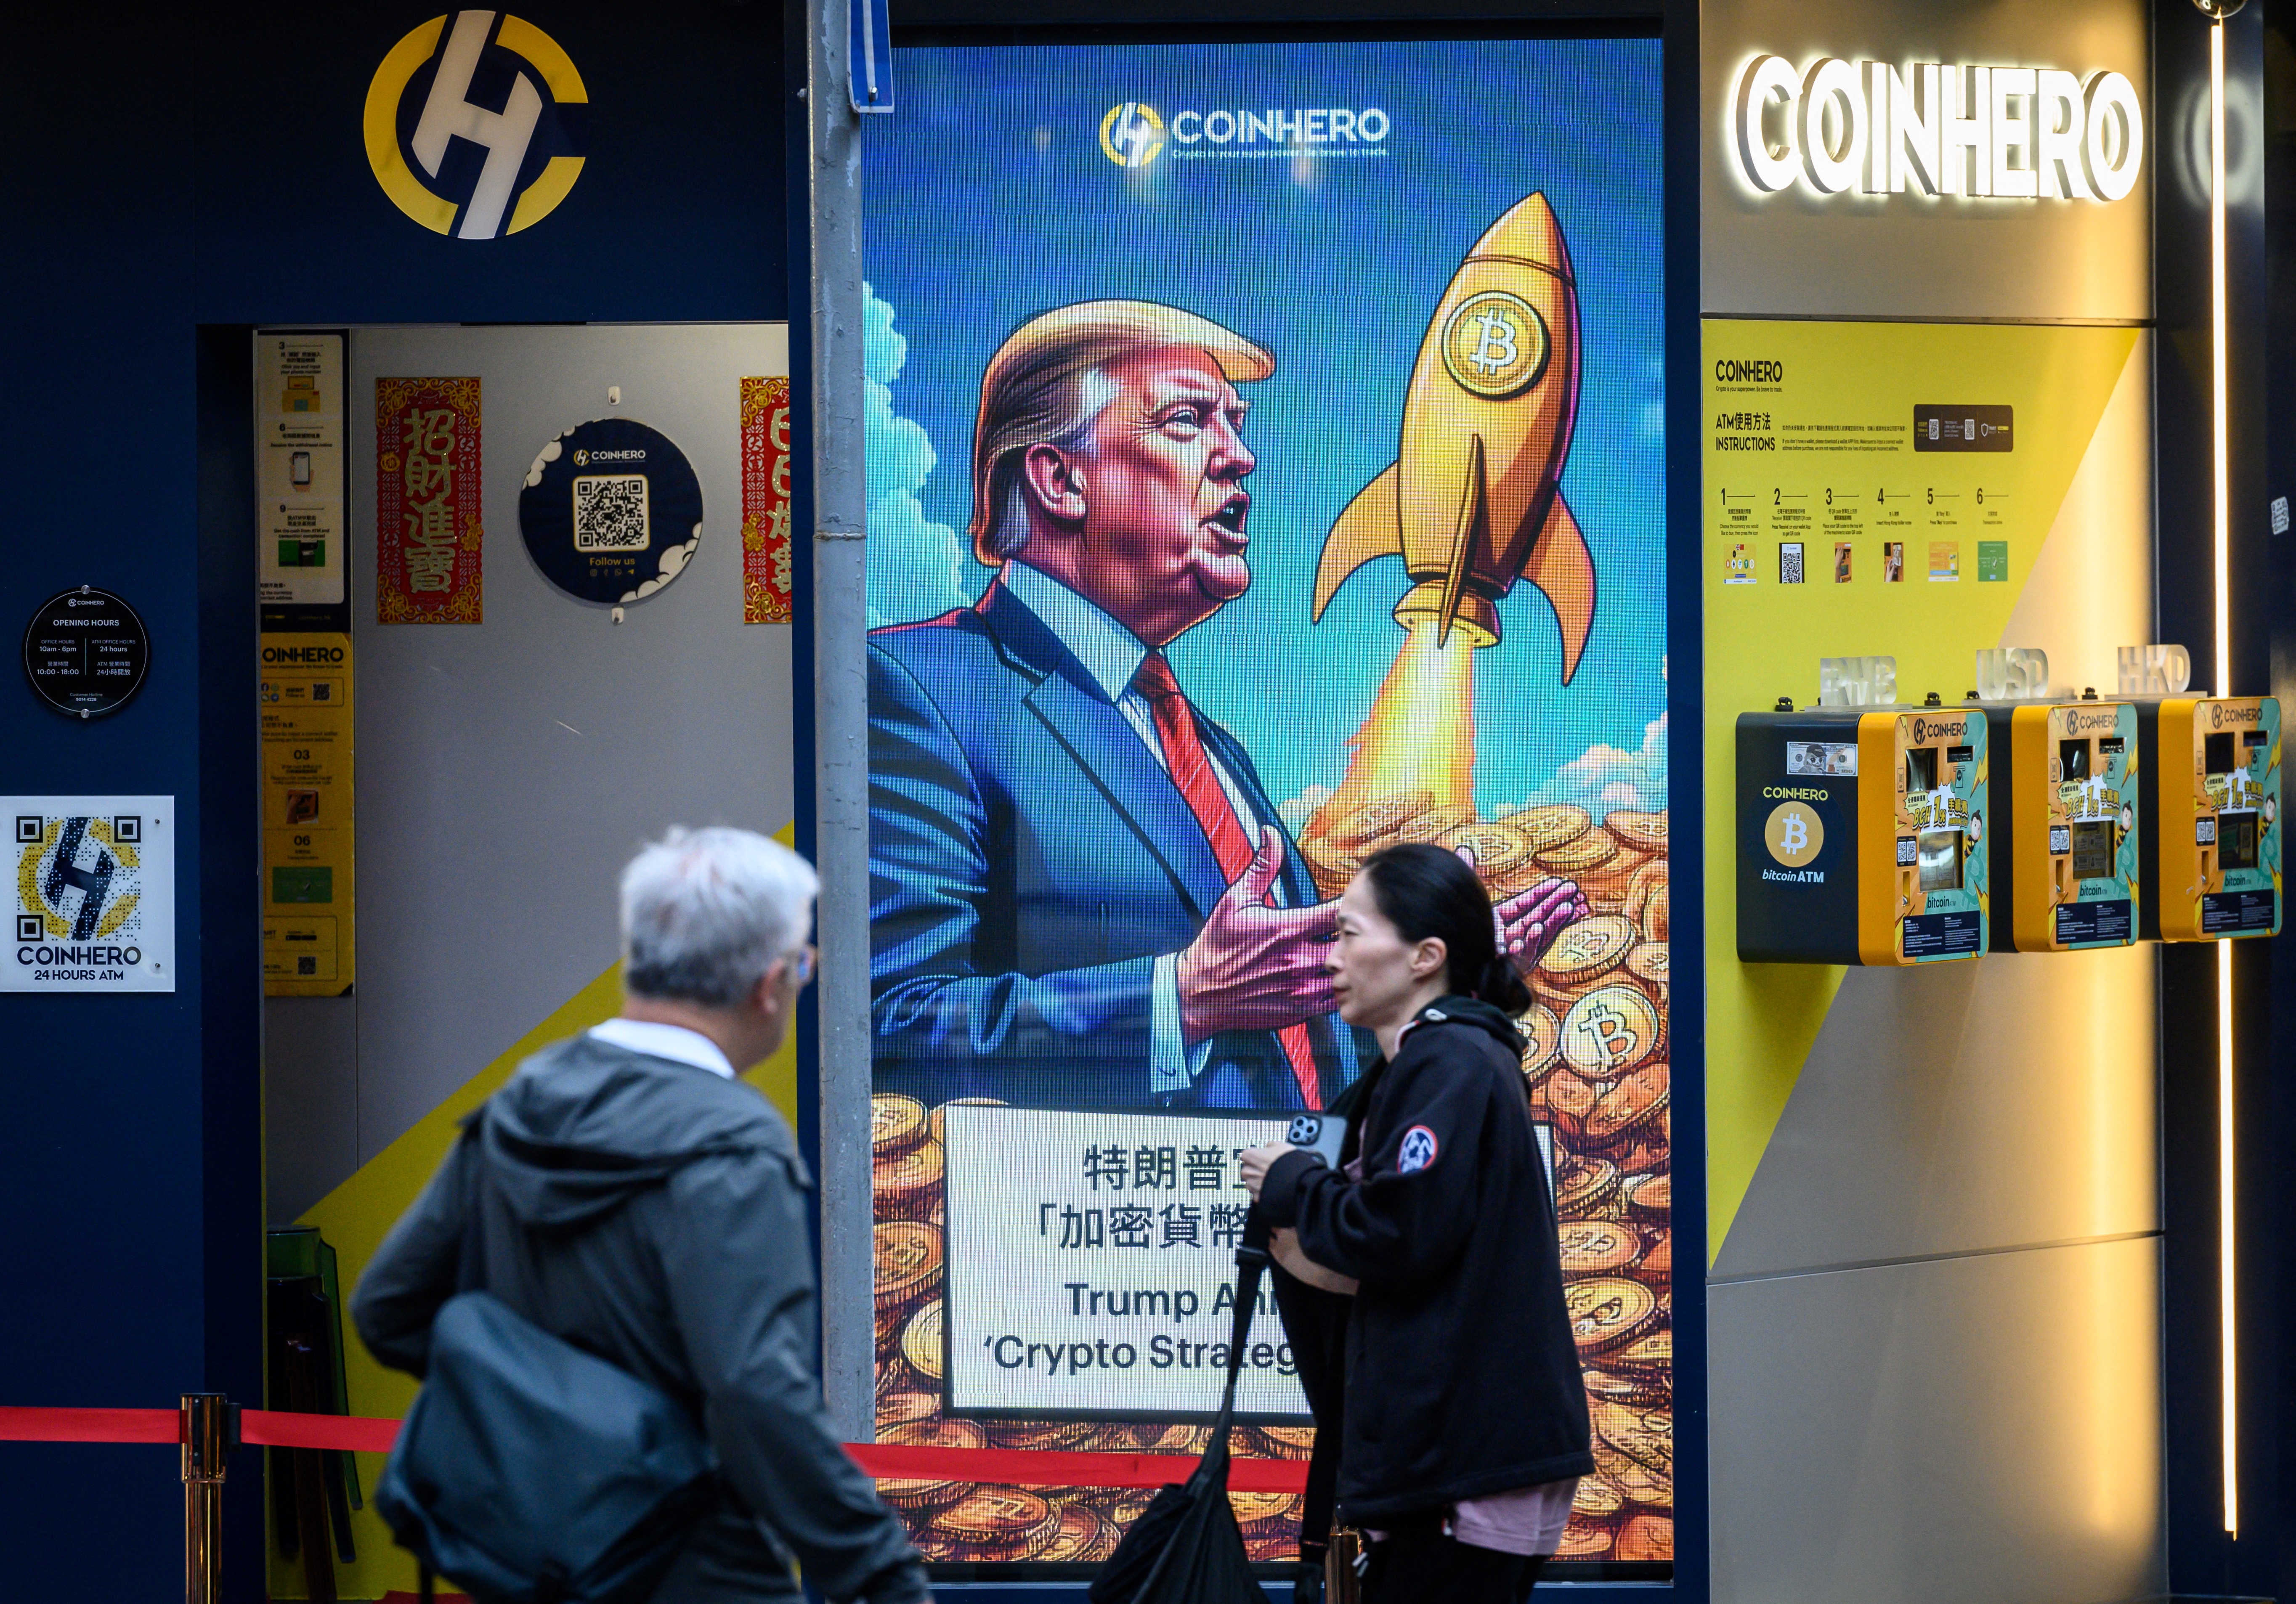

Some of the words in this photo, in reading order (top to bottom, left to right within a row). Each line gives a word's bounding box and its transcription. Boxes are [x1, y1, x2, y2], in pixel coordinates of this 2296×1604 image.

[1172, 108, 1390, 143] COINHERO
[1736, 54, 2142, 201] COINHERO
[1173, 149, 1205, 159] Crypto
[1219, 150, 1241, 159] your
[1319, 148, 1346, 156] brave
[1362, 147, 1390, 156] trade.
[279, 341, 285, 350] 3
[1716, 360, 1782, 382] COINHERO
[1716, 412, 1771, 431] ATM使用方法
[1716, 437, 1775, 451] INSTRUCTIONS
[592, 450, 646, 460] COINHERO
[403, 407, 457, 595] 招財進寶
[1721, 488, 1725, 505] 1
[1774, 488, 1780, 505] 2
[1826, 488, 1832, 505] 3
[1877, 488, 1884, 505] 4
[1927, 488, 1933, 504] 5
[1977, 488, 1983, 504] 6
[590, 557, 621, 566] Follow
[262, 648, 344, 662] OINHERO
[2079, 714, 2119, 729] COINHERO
[2224, 708, 2262, 722] COINHERO
[1927, 722, 1968, 738] COINHERO
[294, 750, 310, 760] 03
[1763, 787, 1828, 801] COINHERO
[2212, 787, 2229, 809] BCH
[1913, 805, 1932, 827] BCH
[1934, 795, 1946, 825] 1%
[2066, 795, 2085, 817] BCH
[294, 835, 311, 846] 06
[1762, 869, 1797, 882] bitcoin
[1797, 871, 1824, 883] ATM
[2224, 875, 2246, 887] bitcoin
[2079, 884, 2102, 898] bitcoin
[1927, 896, 1949, 909] bitcoin
[17, 946, 141, 965] COINHERO
[35, 970, 50, 980] 24
[53, 970, 96, 980] HOURS
[99, 970, 123, 980] ATM
[1064, 1283, 1198, 1323] Trump
